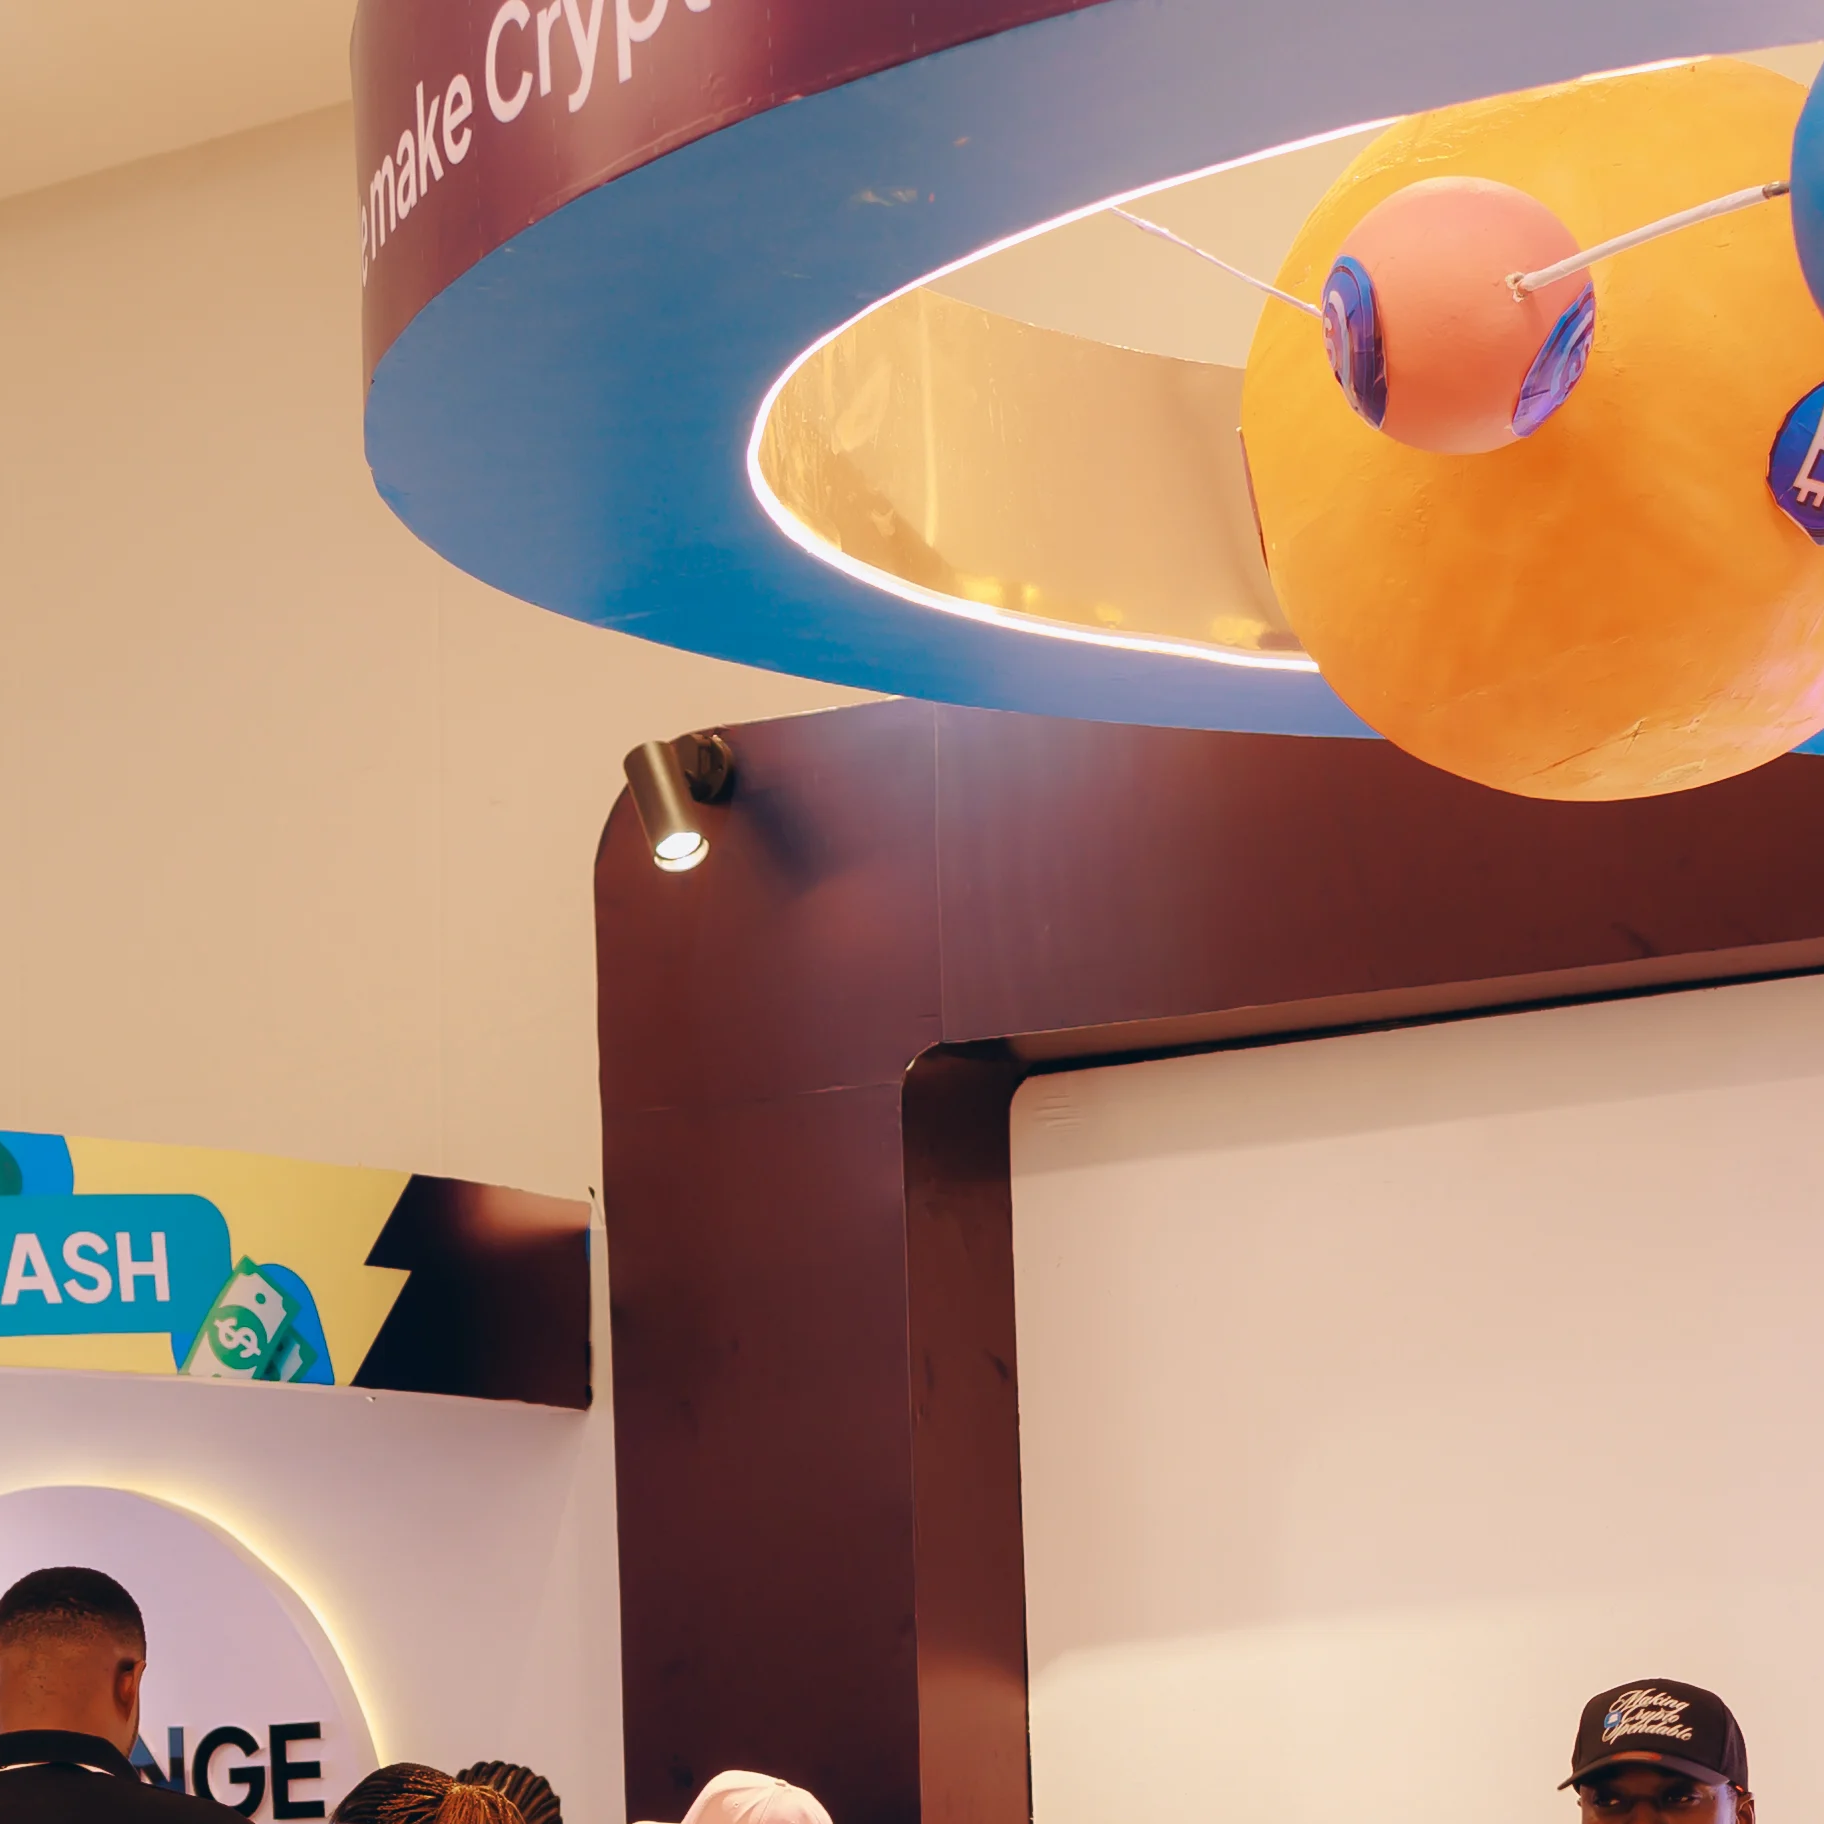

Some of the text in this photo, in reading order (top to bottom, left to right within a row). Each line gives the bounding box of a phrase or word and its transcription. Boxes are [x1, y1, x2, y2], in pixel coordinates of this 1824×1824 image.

[370, 74, 473, 262] make
[485, 0, 712, 123] Cryp
[1609, 1688, 1690, 1712] Making
[1602, 1721, 1693, 1745] Spendable
